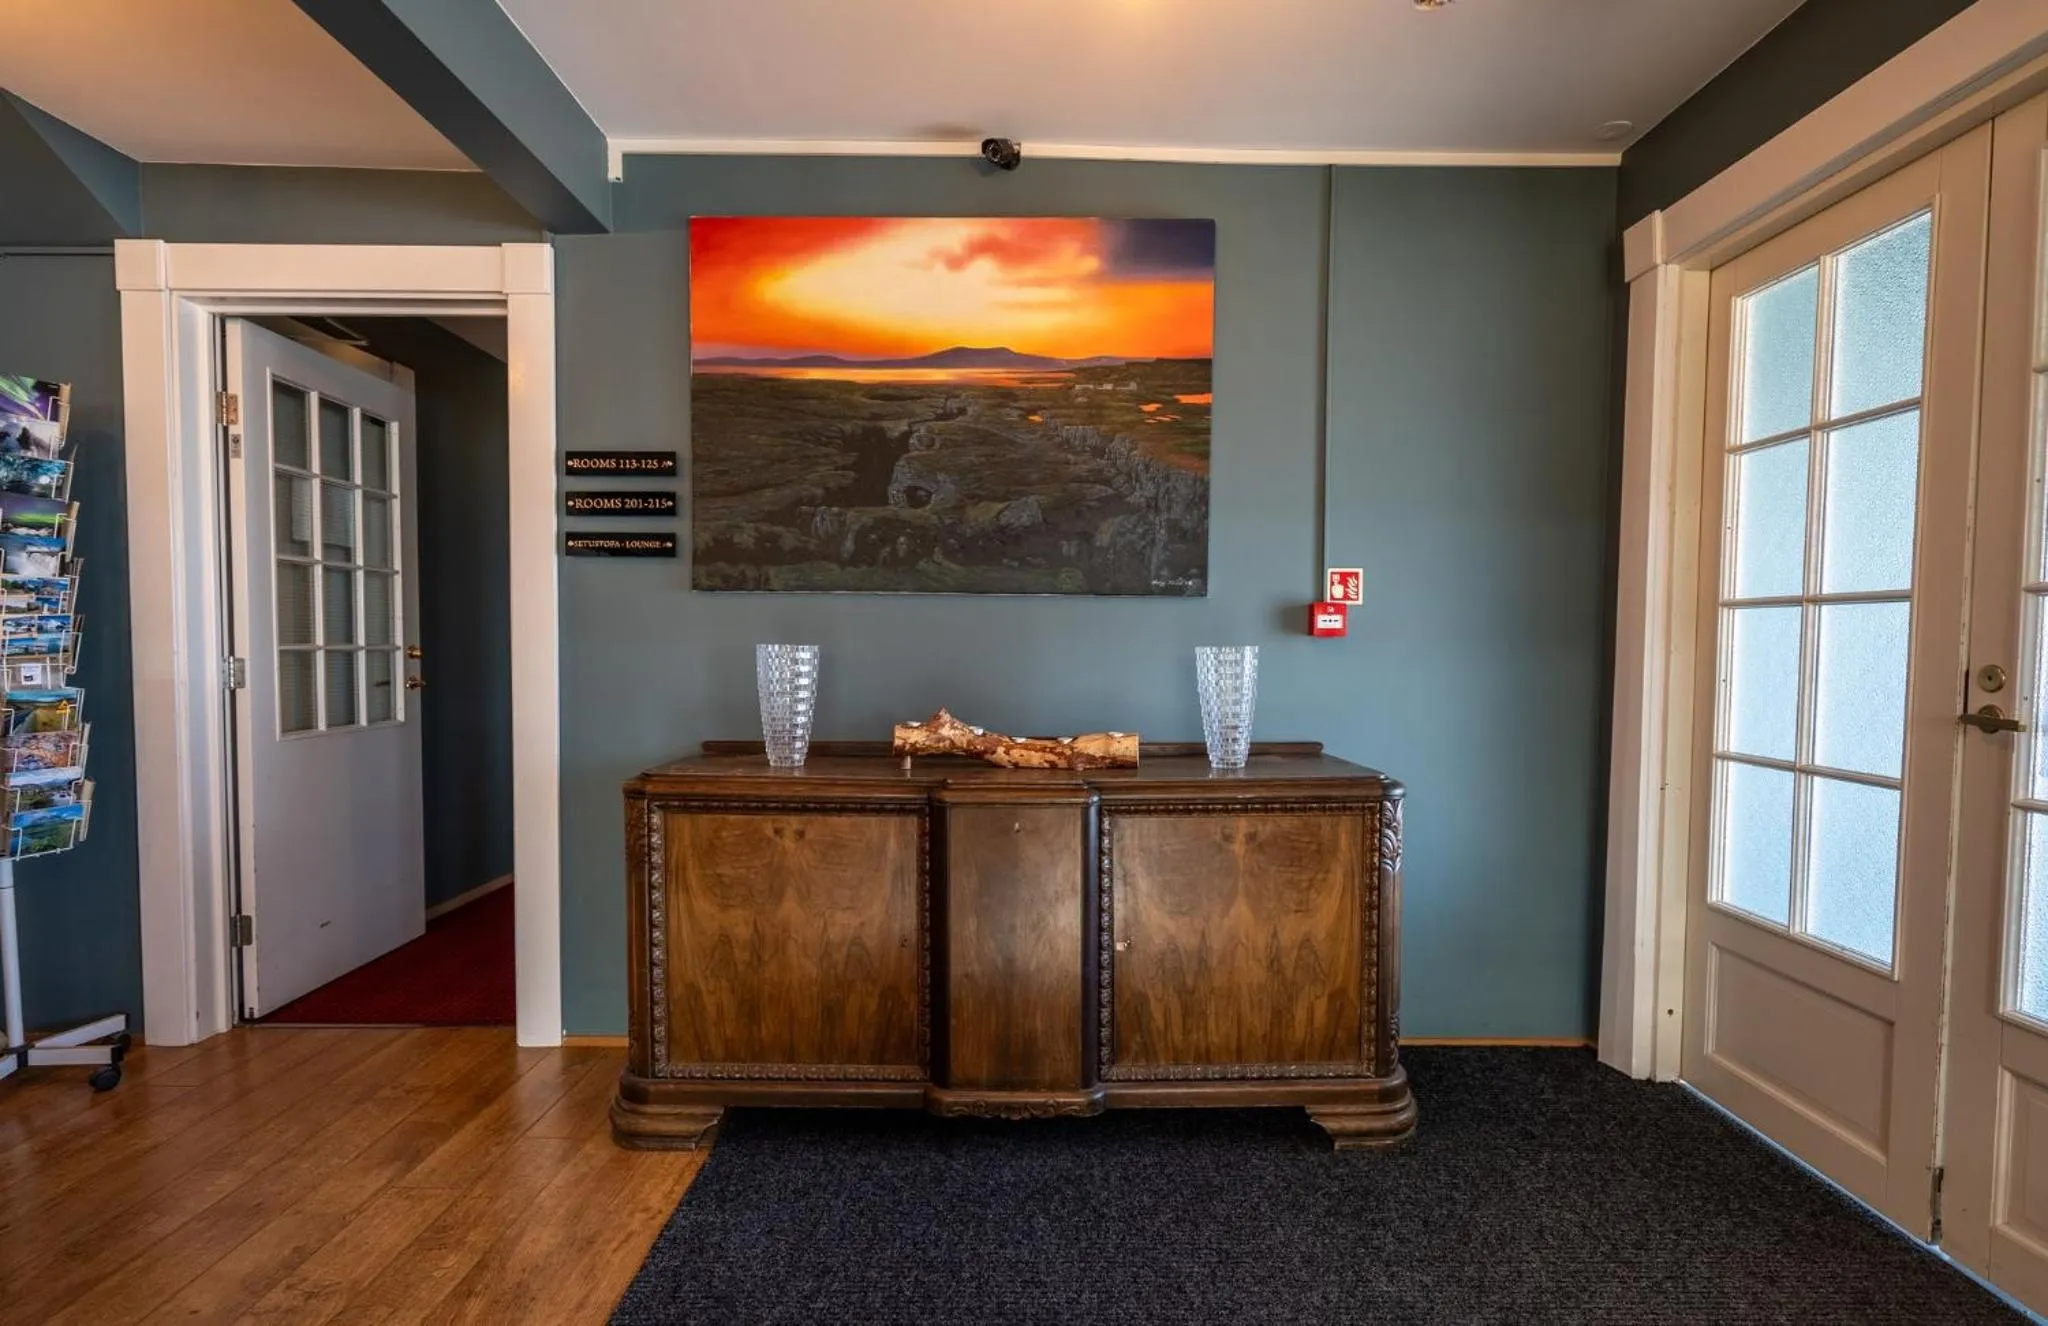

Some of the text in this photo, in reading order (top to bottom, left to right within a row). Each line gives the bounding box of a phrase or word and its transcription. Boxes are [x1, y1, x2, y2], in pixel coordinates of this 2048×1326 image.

[573, 458, 659, 469] ROOMS 113-125
[575, 498, 667, 509] ROOMS 201-215
[626, 541, 662, 549] LOUNGE
